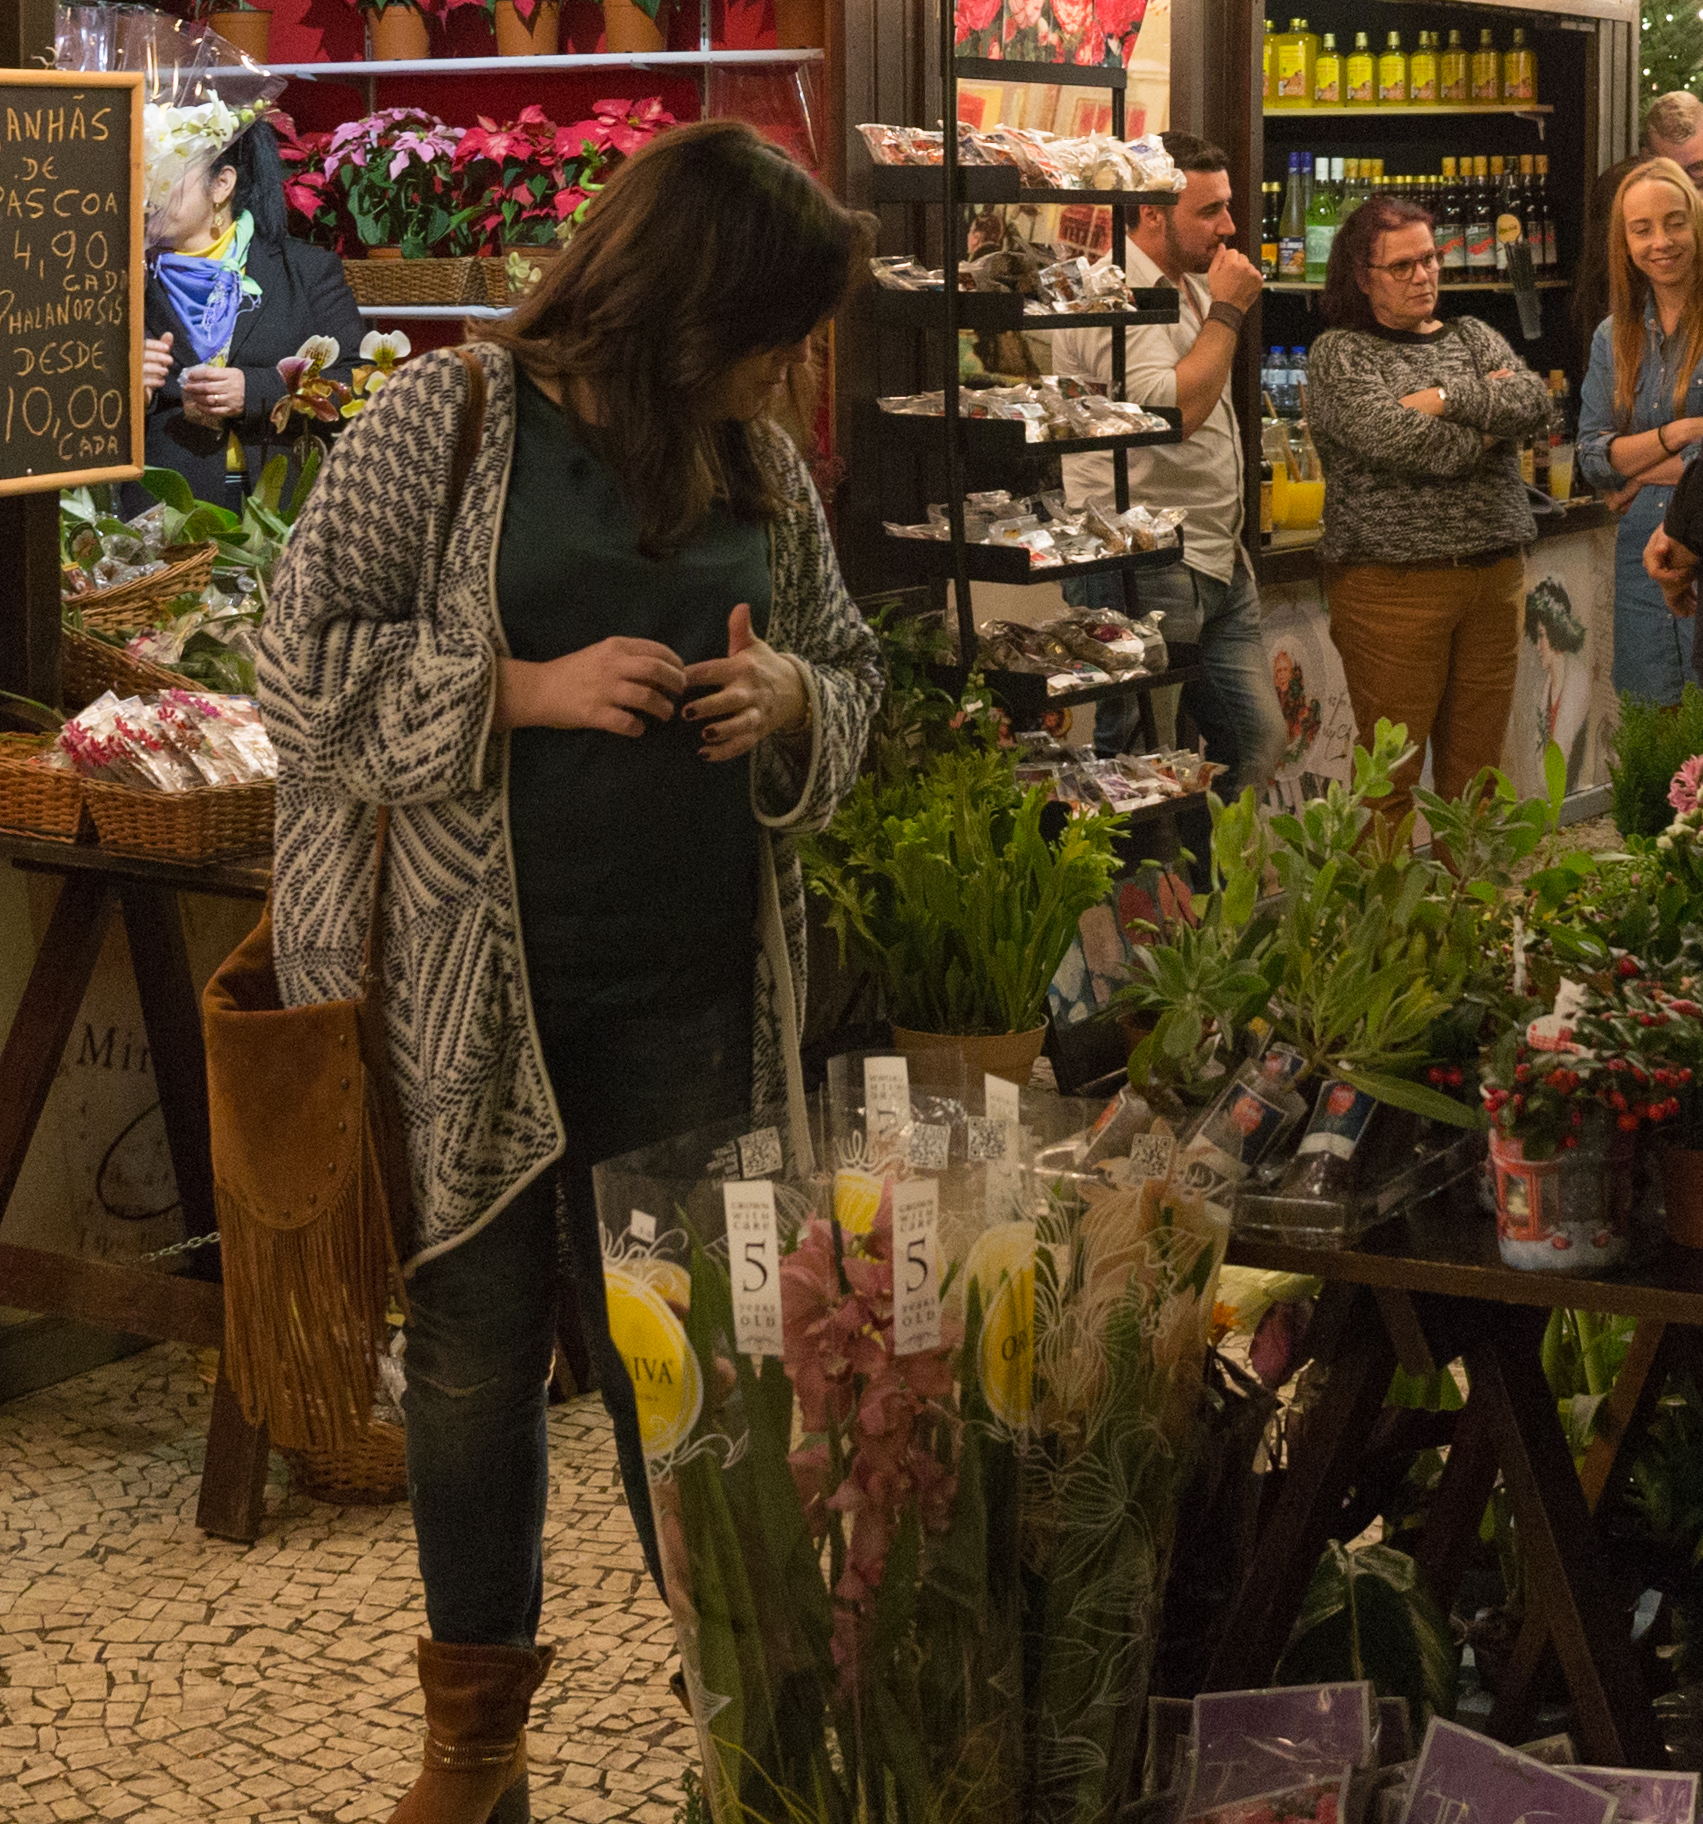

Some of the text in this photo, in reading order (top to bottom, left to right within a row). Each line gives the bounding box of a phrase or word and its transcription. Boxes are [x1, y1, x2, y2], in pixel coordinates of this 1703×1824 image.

[21, 156, 59, 181] DE
[14, 229, 109, 279] 4,90
[13, 340, 107, 377] DESDE
[5, 384, 124, 444] 10,00
[58, 432, 119, 461] CADA
[743, 1242, 767, 1293] 5
[906, 1238, 928, 1295] 5
[740, 1314, 776, 1327] OLD
[902, 1310, 935, 1327] OLD
